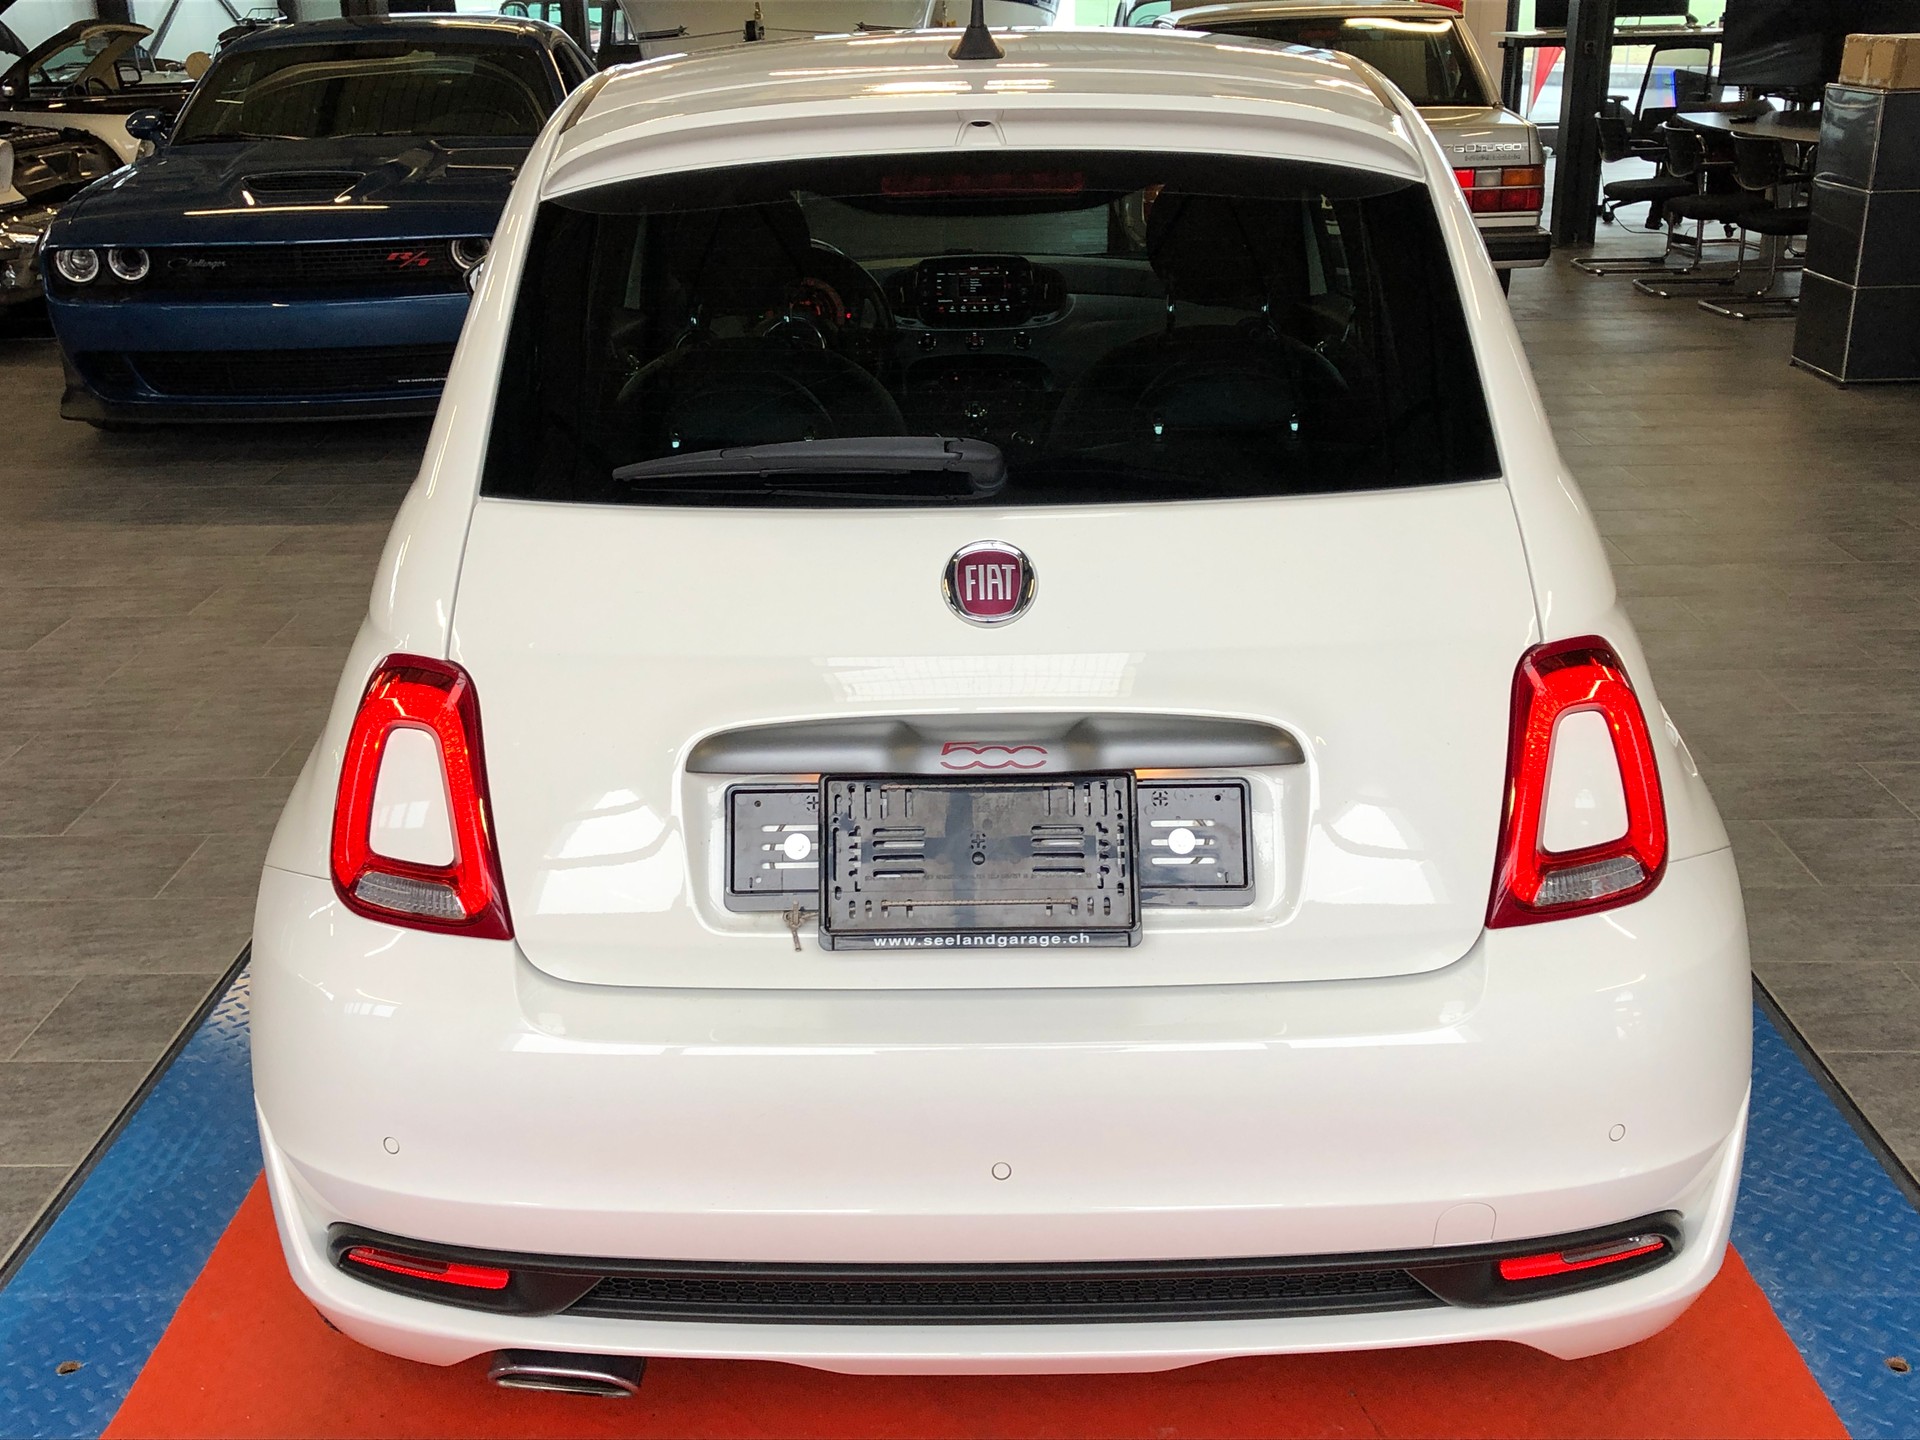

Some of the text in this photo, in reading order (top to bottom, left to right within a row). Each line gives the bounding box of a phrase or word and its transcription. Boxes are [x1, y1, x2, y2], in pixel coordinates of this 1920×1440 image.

[1478, 143, 1522, 152] TURBO
[965, 563, 1016, 601] FIAT
[940, 741, 1048, 770] 500
[873, 933, 1090, 947] www.seelandgarage.ch
